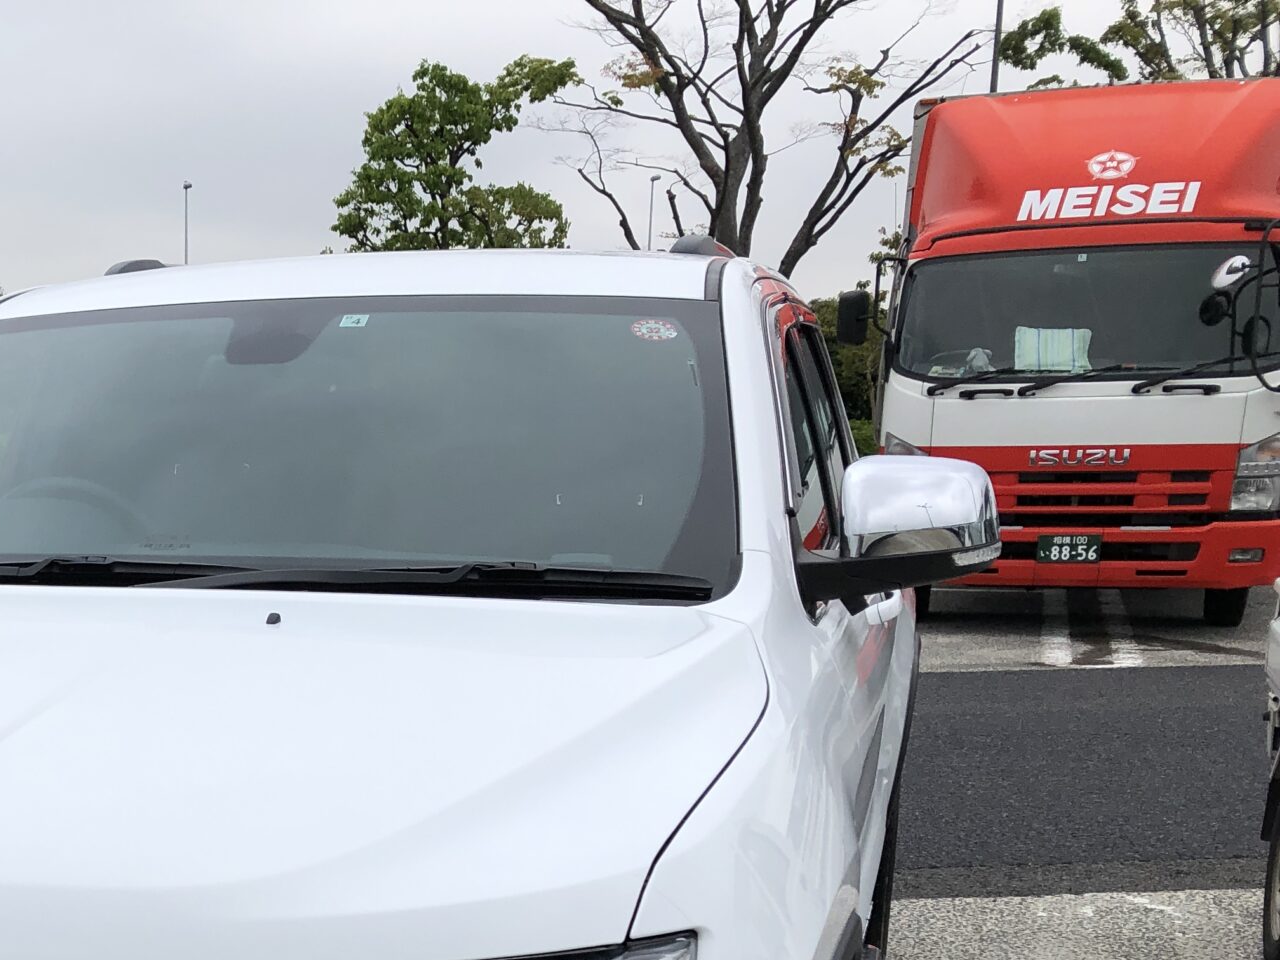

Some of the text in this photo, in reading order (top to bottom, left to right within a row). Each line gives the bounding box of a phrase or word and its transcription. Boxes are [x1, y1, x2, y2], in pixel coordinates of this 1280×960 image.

[1106, 160, 1118, 168] M
[1016, 181, 1202, 222] MEISEI
[1029, 448, 1131, 466] ISUZU
[1050, 545, 1098, 561] 88-56
